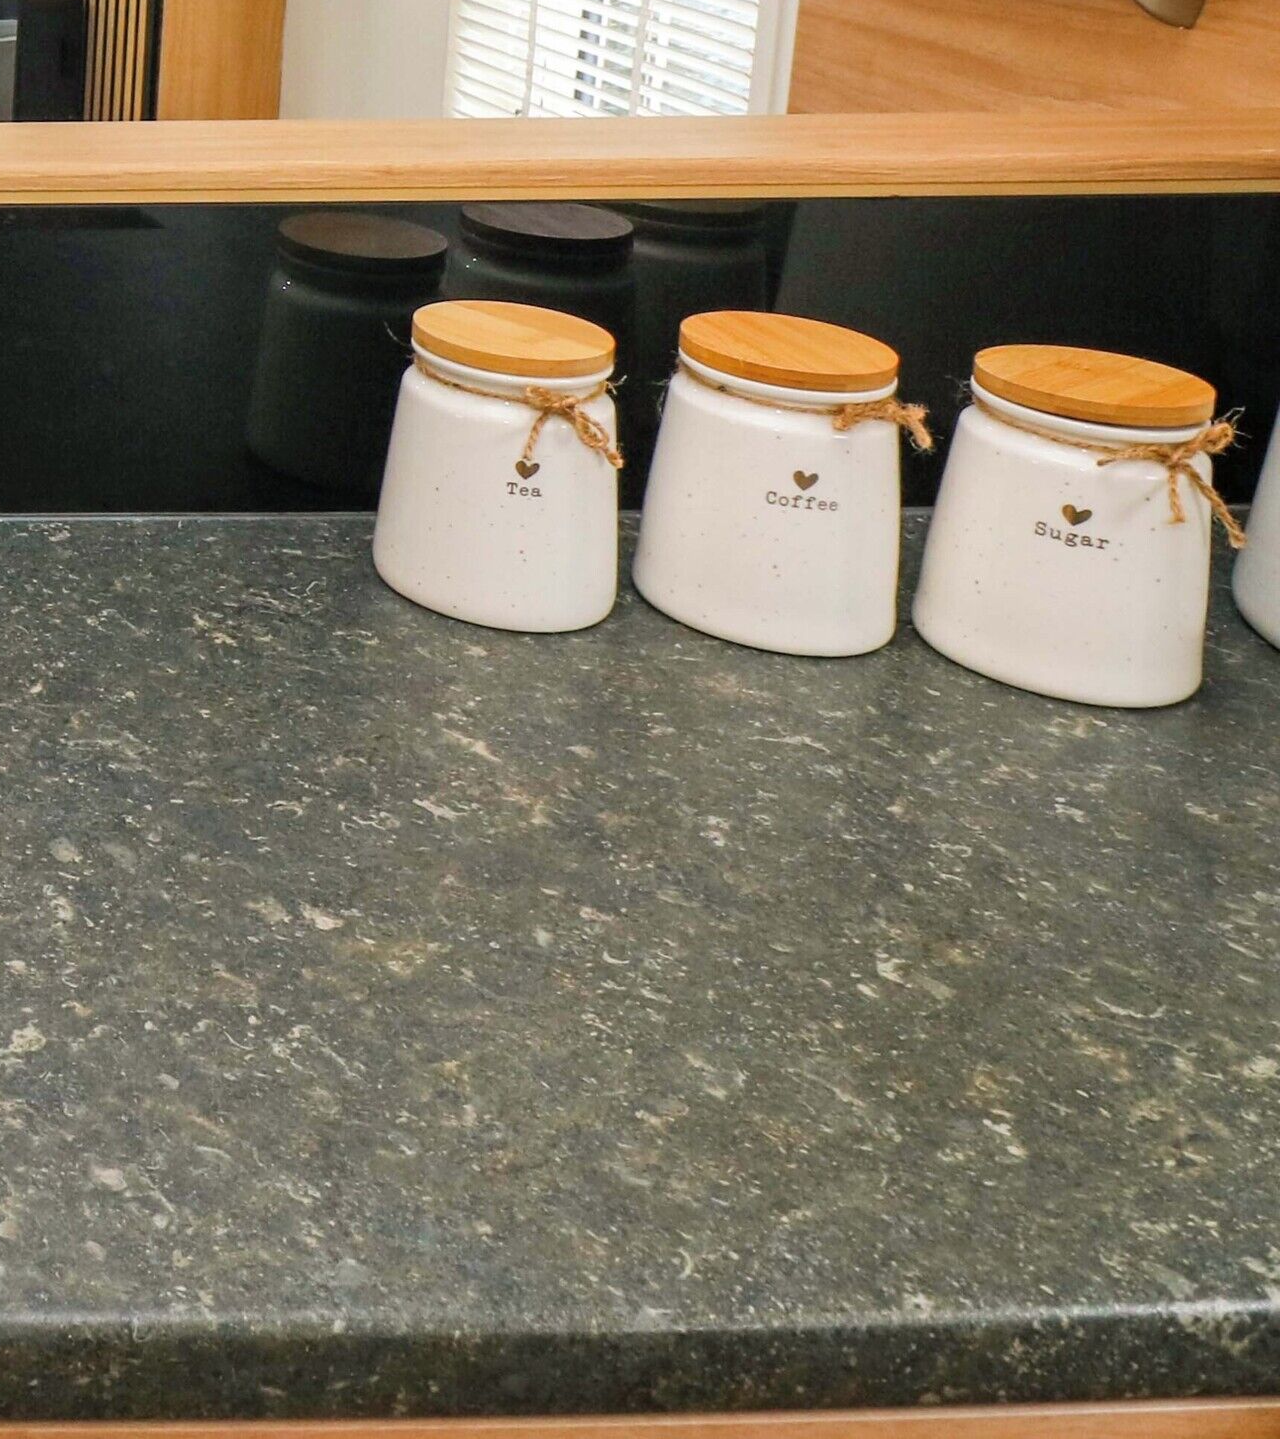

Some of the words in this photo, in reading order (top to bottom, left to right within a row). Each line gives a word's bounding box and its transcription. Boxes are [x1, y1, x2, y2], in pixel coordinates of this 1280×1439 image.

[506, 482, 542, 497] Tea
[766, 490, 838, 511] Coffee
[1034, 521, 1110, 550] Sugar
